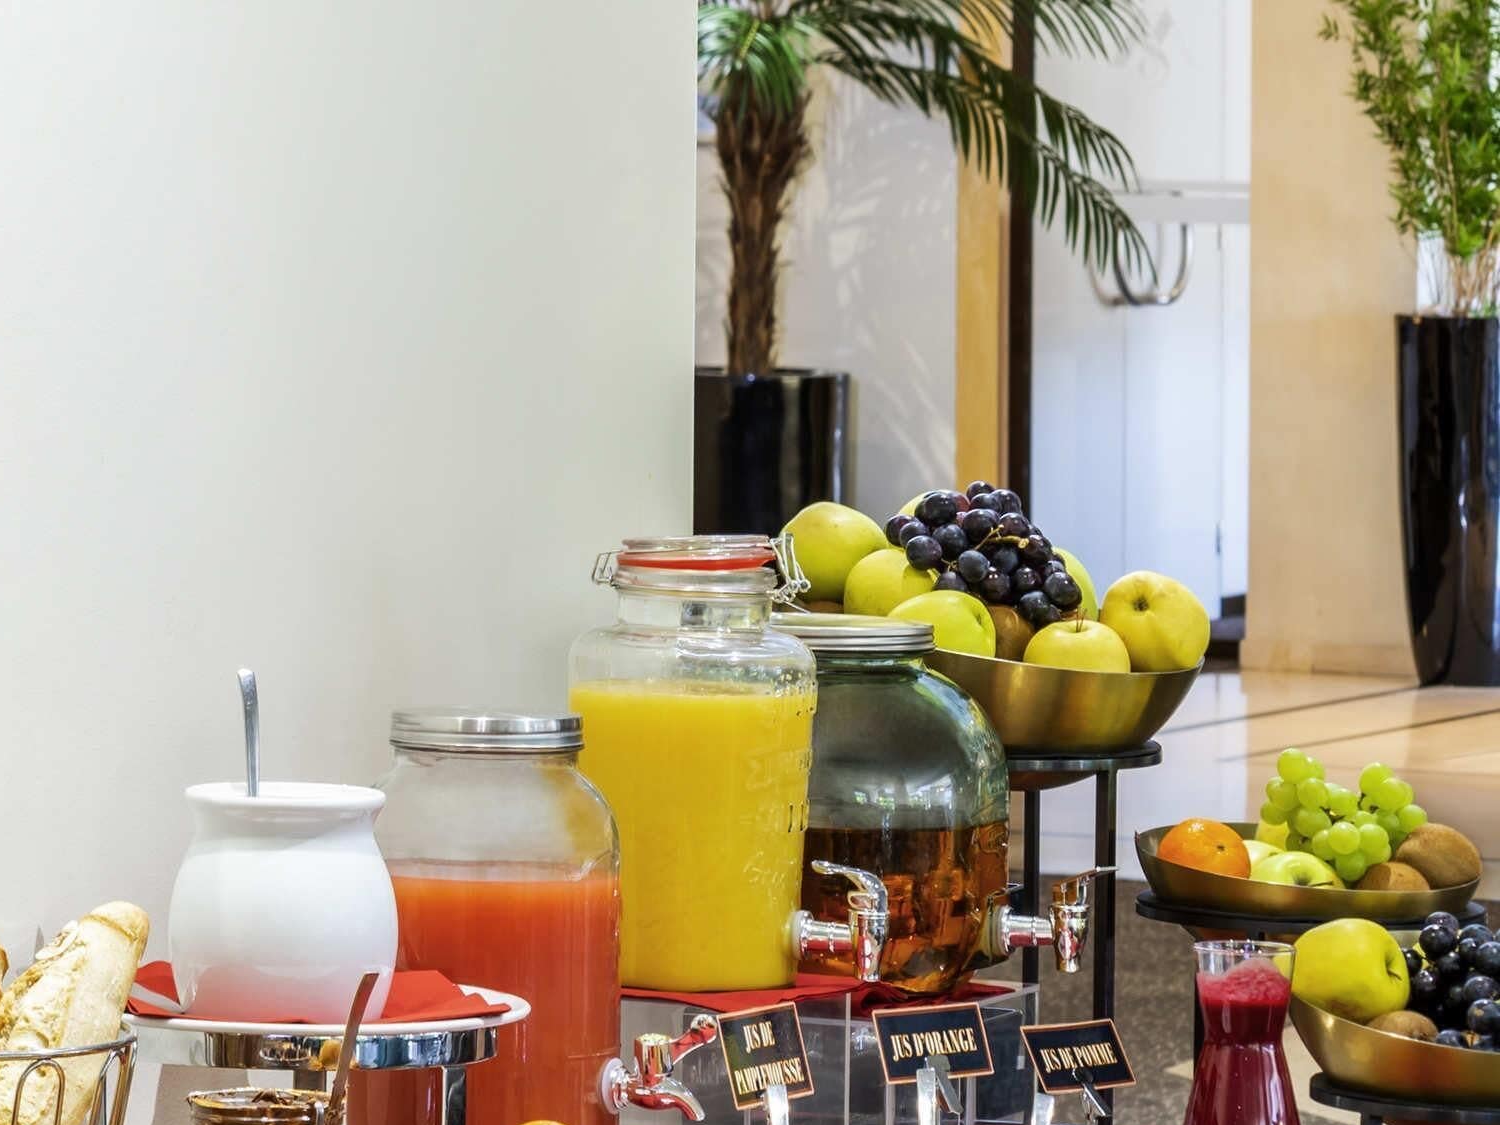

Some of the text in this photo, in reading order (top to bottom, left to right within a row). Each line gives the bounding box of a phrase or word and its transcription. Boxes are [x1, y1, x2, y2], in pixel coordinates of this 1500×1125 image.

[743, 1021, 775, 1053] JUS DE
[890, 1027, 978, 1062] JUS D'ORANGE
[1040, 1042, 1118, 1074] JUS DE POMME
[734, 1057, 805, 1096] PAMPLEMOUSSE
